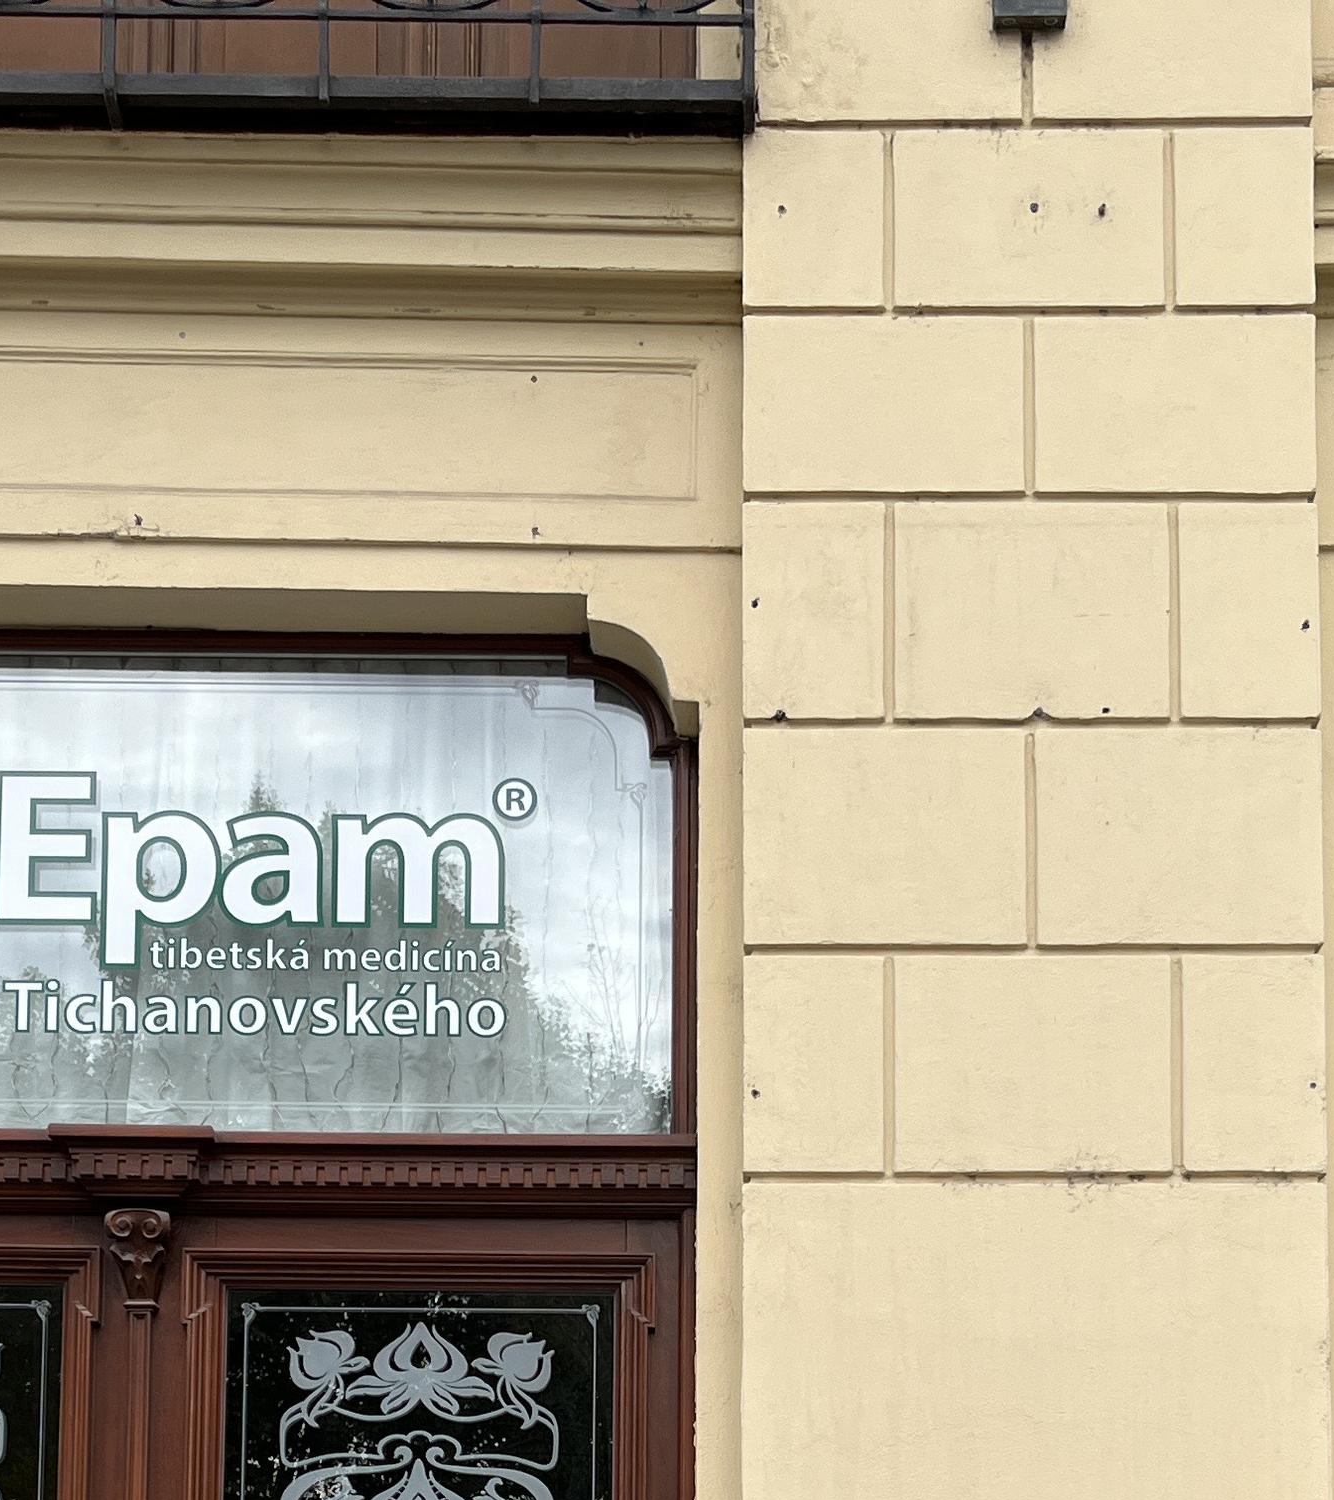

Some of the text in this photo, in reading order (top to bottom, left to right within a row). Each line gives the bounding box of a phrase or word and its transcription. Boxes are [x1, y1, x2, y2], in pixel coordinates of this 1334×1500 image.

[149, 937, 502, 973] tibetská medicína
[4, 979, 506, 1038] Tichanovského
